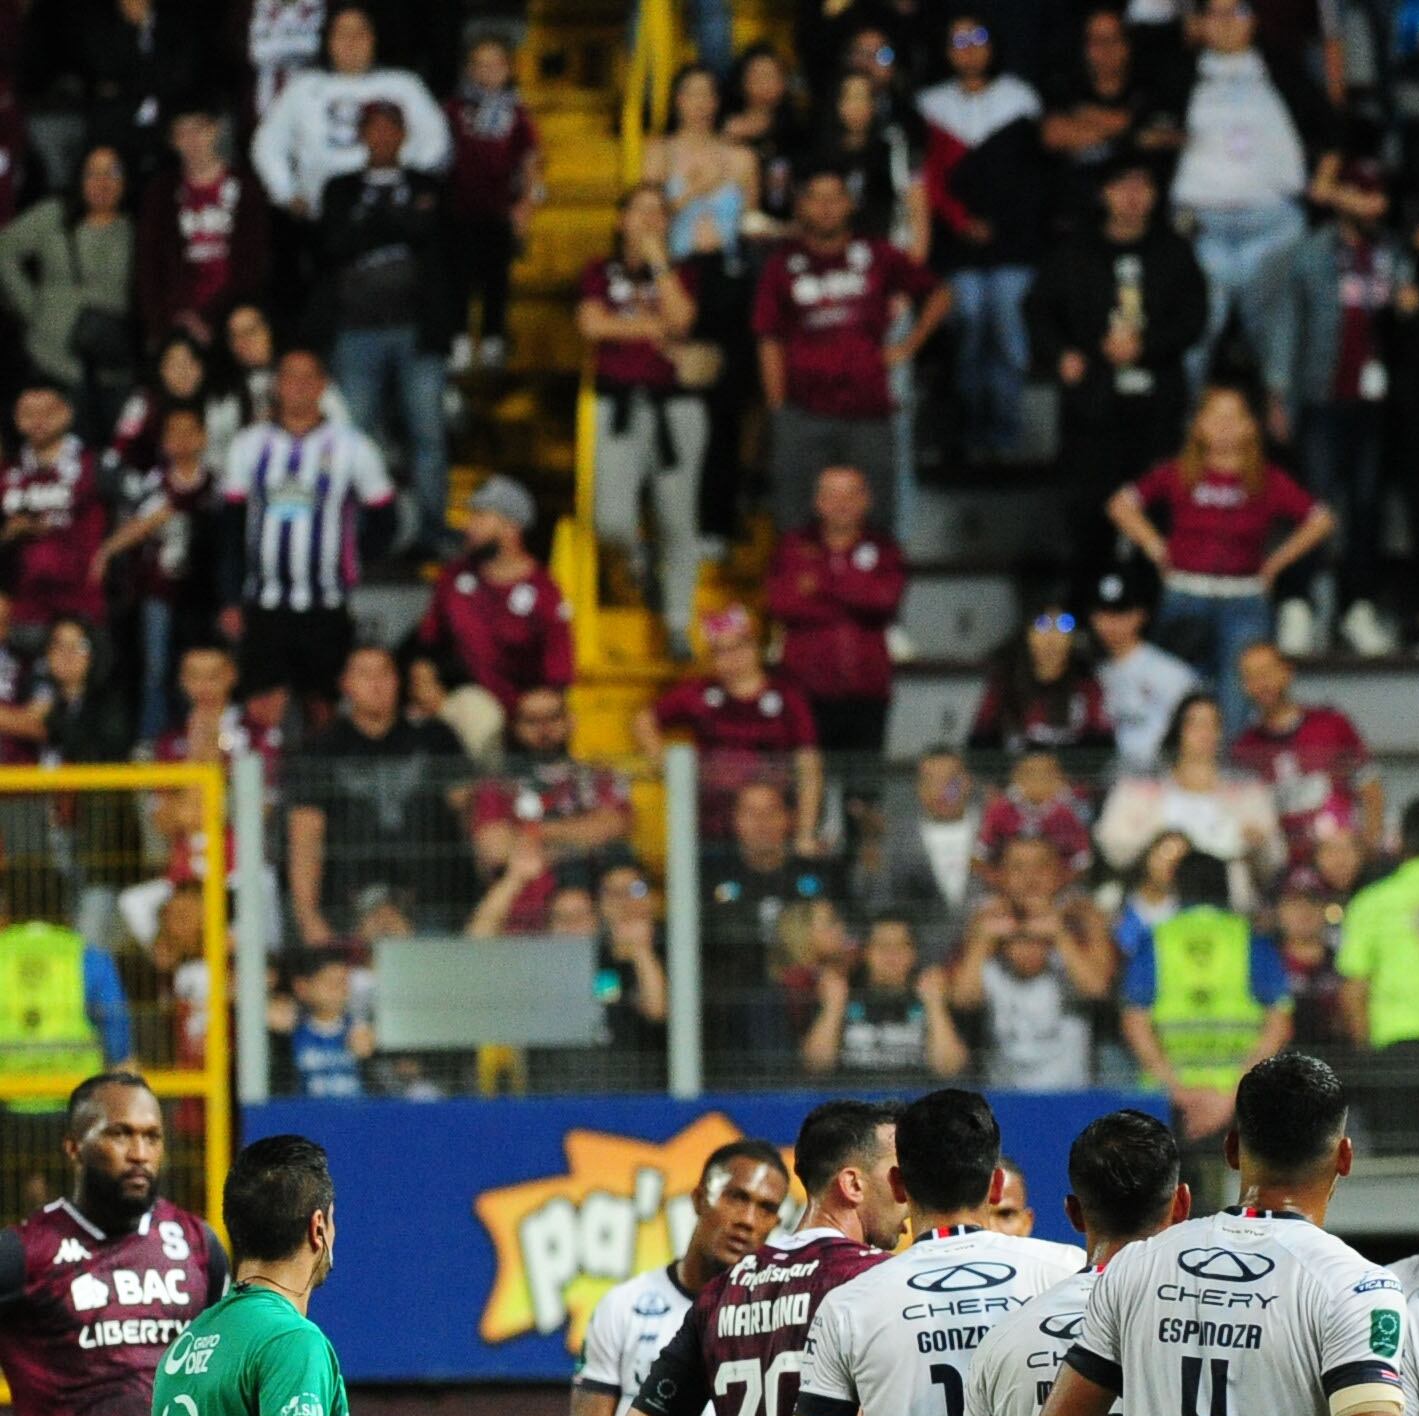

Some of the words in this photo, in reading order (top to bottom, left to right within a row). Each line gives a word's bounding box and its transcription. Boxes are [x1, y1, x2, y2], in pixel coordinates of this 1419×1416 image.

[159, 1221, 190, 1261] S
[113, 1268, 190, 1305] BAC
[1157, 1284, 1280, 1310] CHERY
[718, 1292, 811, 1338] MARIANO
[902, 1295, 1033, 1321] CHERY
[79, 1318, 192, 1350] LIBERTY
[1158, 1317, 1263, 1350] ESPINOZA
